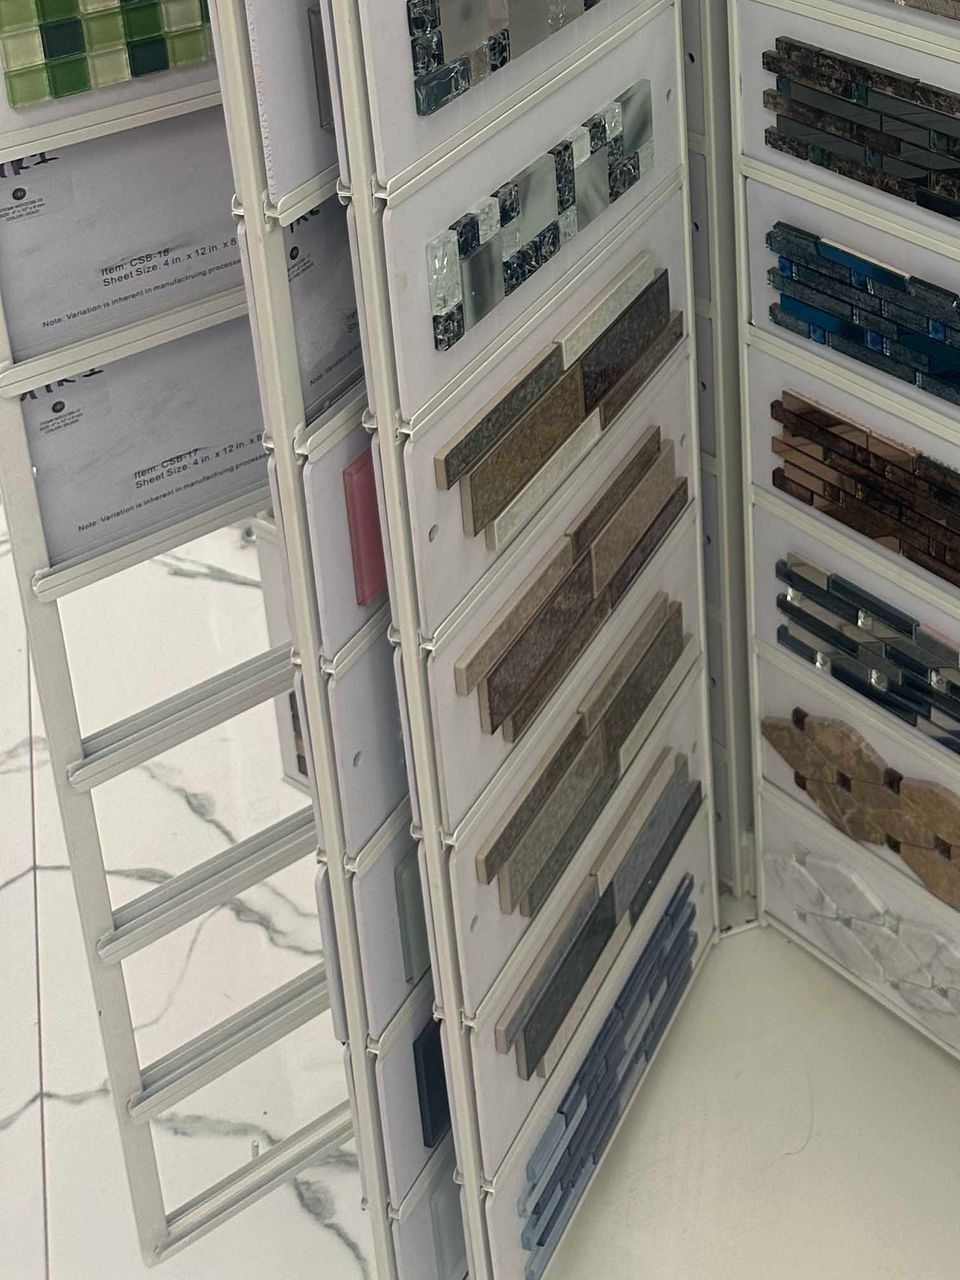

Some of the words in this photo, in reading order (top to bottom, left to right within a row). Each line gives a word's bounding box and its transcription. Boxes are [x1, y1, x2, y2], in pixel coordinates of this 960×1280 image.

[103, 272, 134, 287] Sheet
[163, 259, 170, 267] 4
[195, 246, 207, 257] 12
[130, 248, 170, 267] CSB-18
[66, 304, 102, 320] Variation
[103, 301, 110, 309] is
[112, 288, 144, 306] inherent
[145, 287, 152, 295] in
[135, 473, 165, 489] Sheet
[193, 458, 199, 466] 4
[223, 444, 234, 455] 12
[100, 505, 135, 522] Variation
[135, 501, 142, 509] is
[143, 489, 174, 506] inherent
